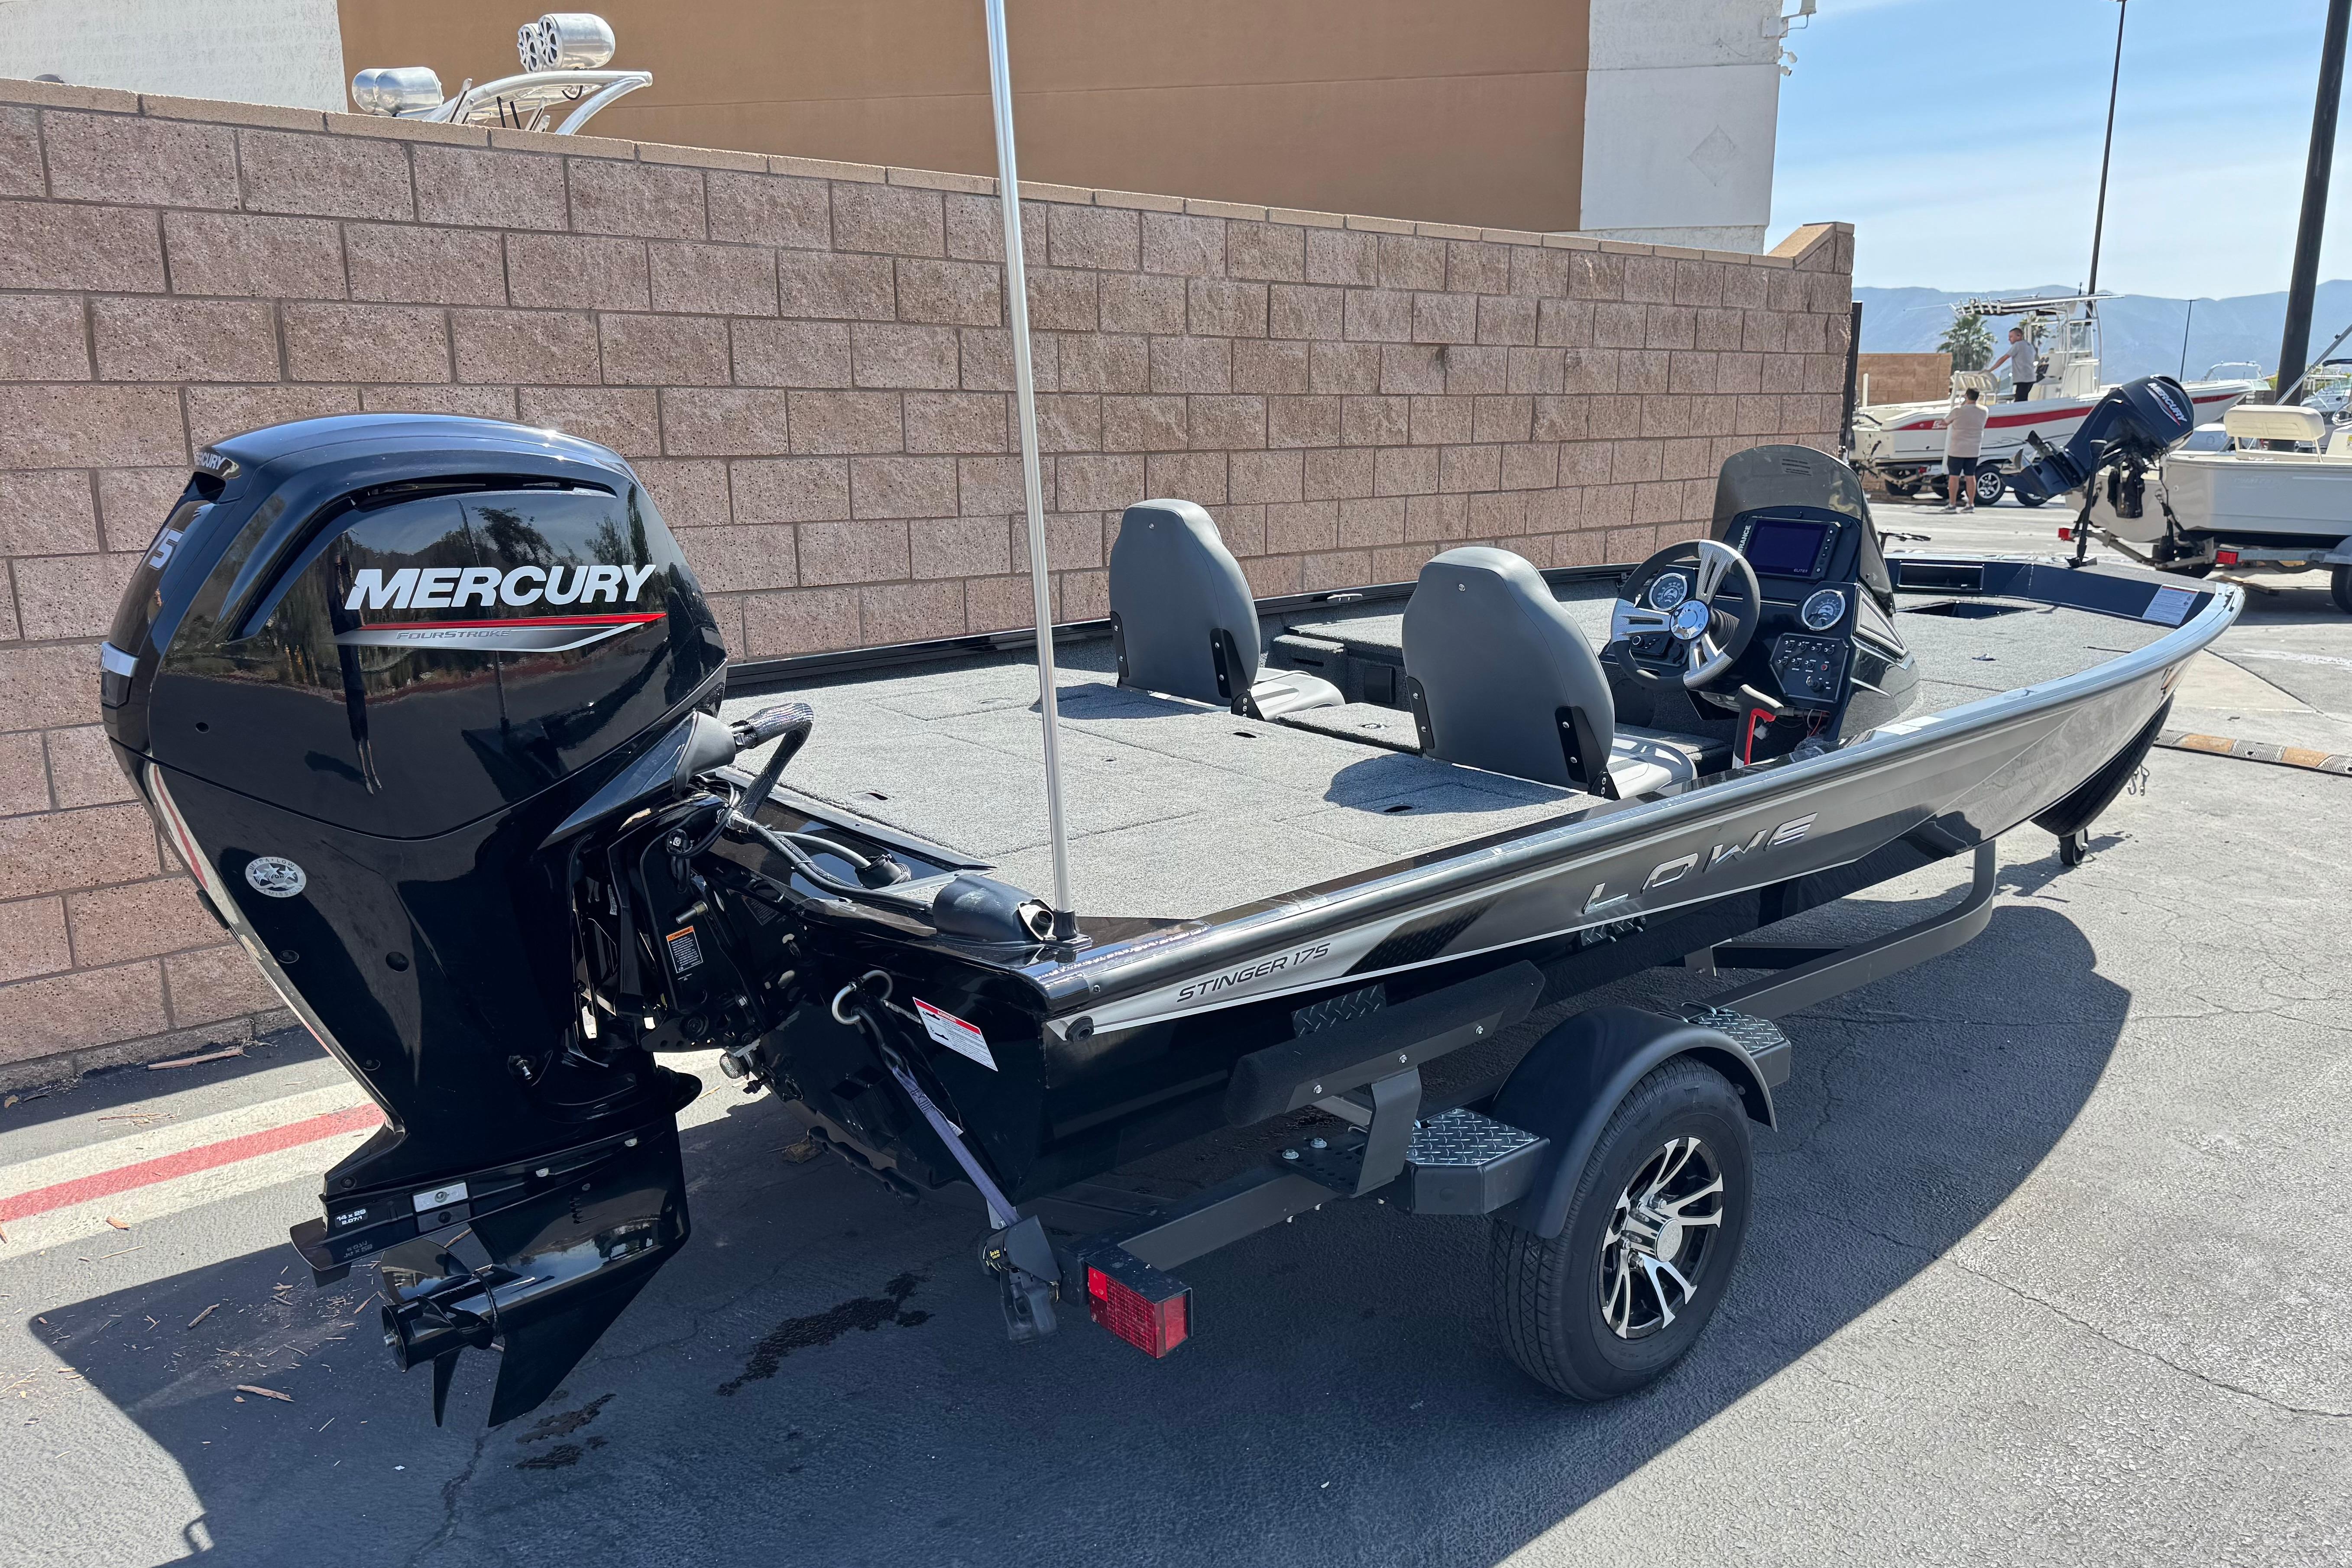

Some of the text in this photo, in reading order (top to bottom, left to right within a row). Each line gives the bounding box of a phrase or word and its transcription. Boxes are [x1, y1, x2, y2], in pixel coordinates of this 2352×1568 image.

[2148, 382, 2187, 422] MERCURY
[195, 452, 226, 470] ERCURY
[344, 564, 656, 610] MERCURY
[249, 858, 295, 870] ULTRA LOW
[1581, 812, 1818, 915] LOWE
[1176, 943, 1331, 1002] STINGER 175
[342, 1215, 363, 1225] 2.07:1
